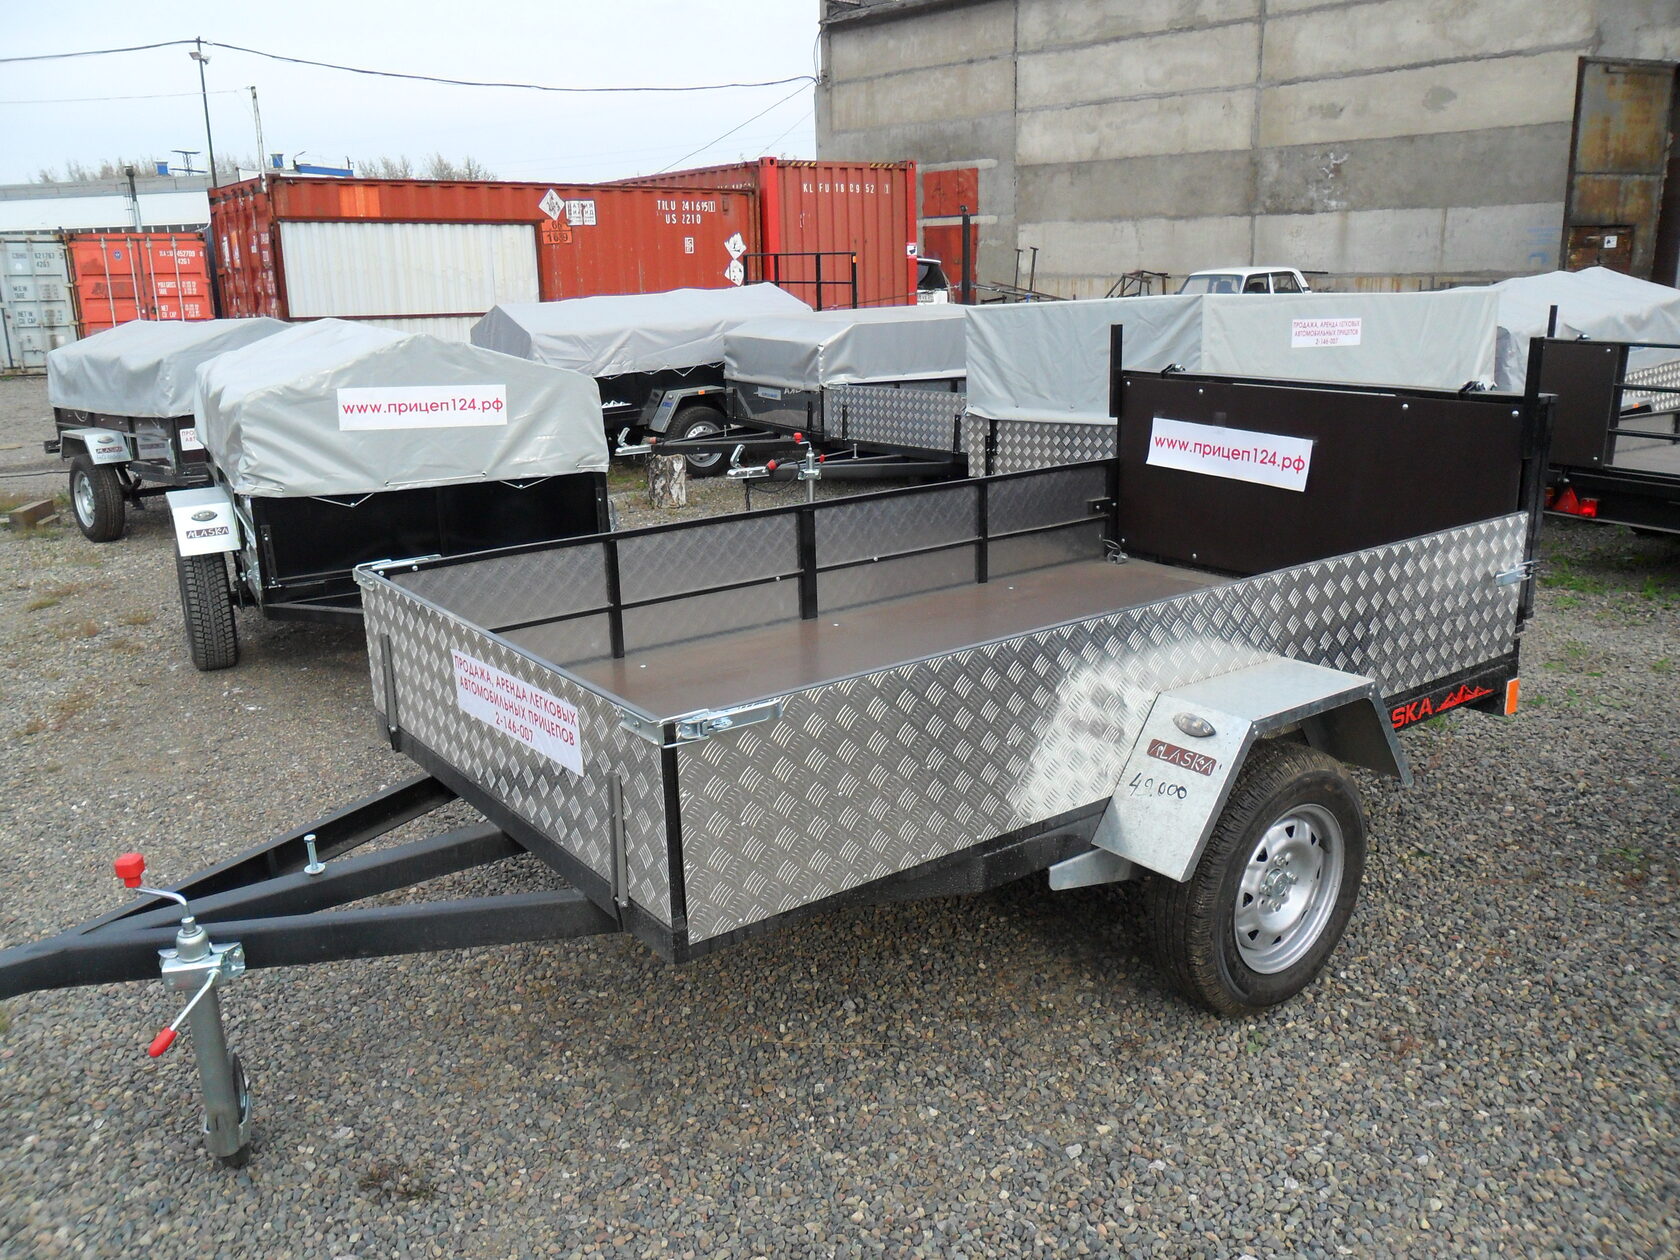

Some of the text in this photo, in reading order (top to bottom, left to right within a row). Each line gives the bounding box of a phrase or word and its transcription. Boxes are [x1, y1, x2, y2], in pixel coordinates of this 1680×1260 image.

[665, 213, 677, 224] US
[342, 397, 504, 416] www.прицеп124.рф
[1154, 436, 1305, 474] www.прицеп124.рф
[186, 526, 229, 539] ALASKA
[454, 655, 577, 727] ПРОДАЖА, АРЕНДА ЛЕГКОВЫХ
[460, 677, 575, 746] АВТОМОБИЛЬНЫХ ПРИЦЕПОВ
[495, 712, 534, 744] 2-146-007
[1148, 741, 1214, 775] ALASKA
